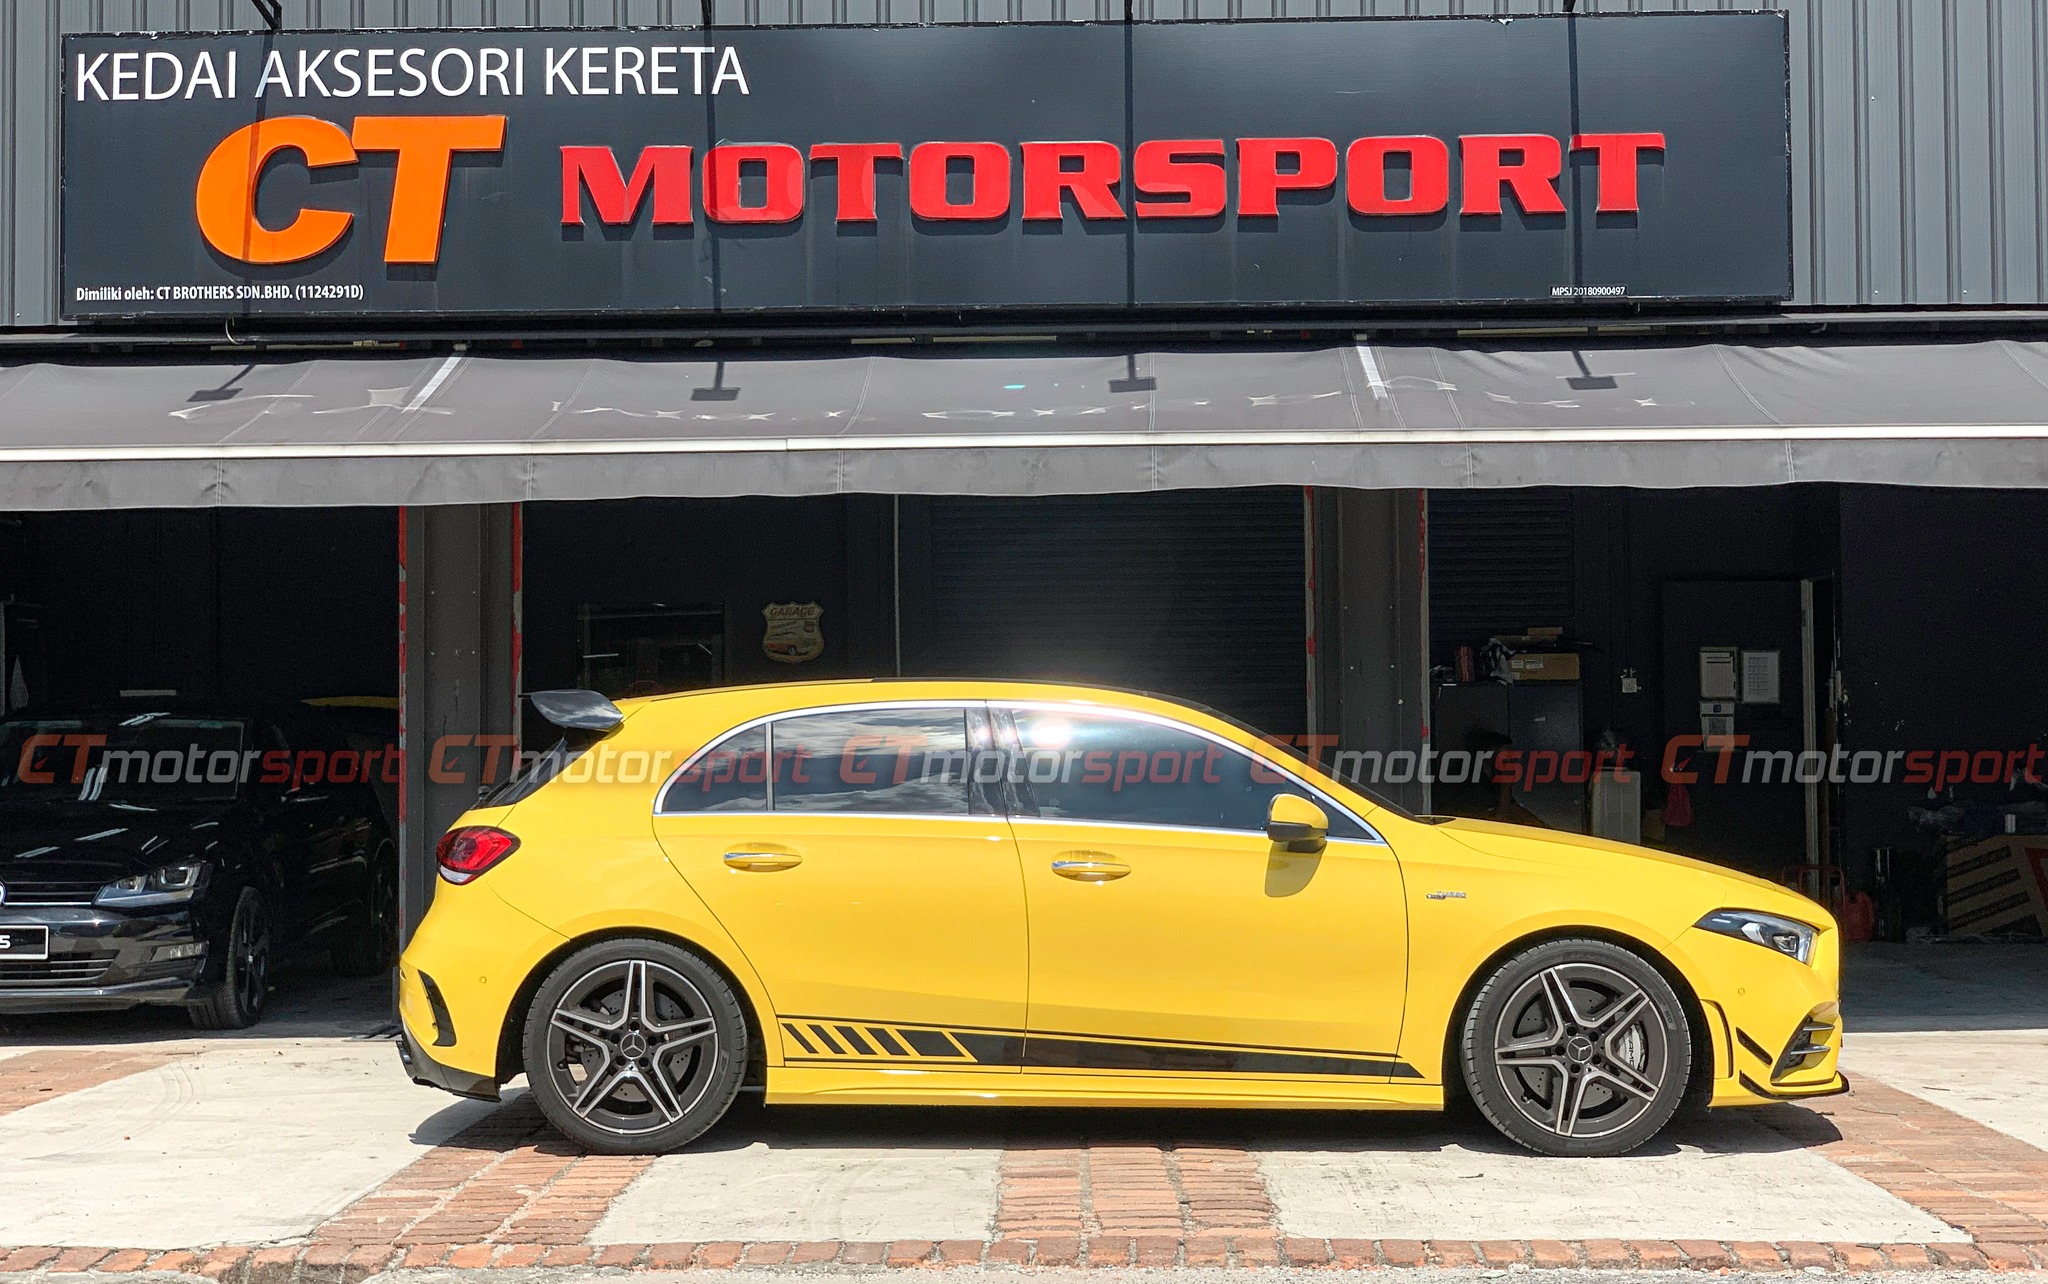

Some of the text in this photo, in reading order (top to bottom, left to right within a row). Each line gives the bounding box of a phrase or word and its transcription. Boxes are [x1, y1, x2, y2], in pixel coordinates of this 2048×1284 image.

[76, 45, 750, 102] KEDAI AKSESORI KERETA
[195, 114, 1667, 265] CT MOTORSPORT
[76, 284, 364, 301] Dimiliki oleh: CT BROTHERS SDN.BHD. (1124291D)
[1551, 286, 1626, 296] MPSJ 20180900497
